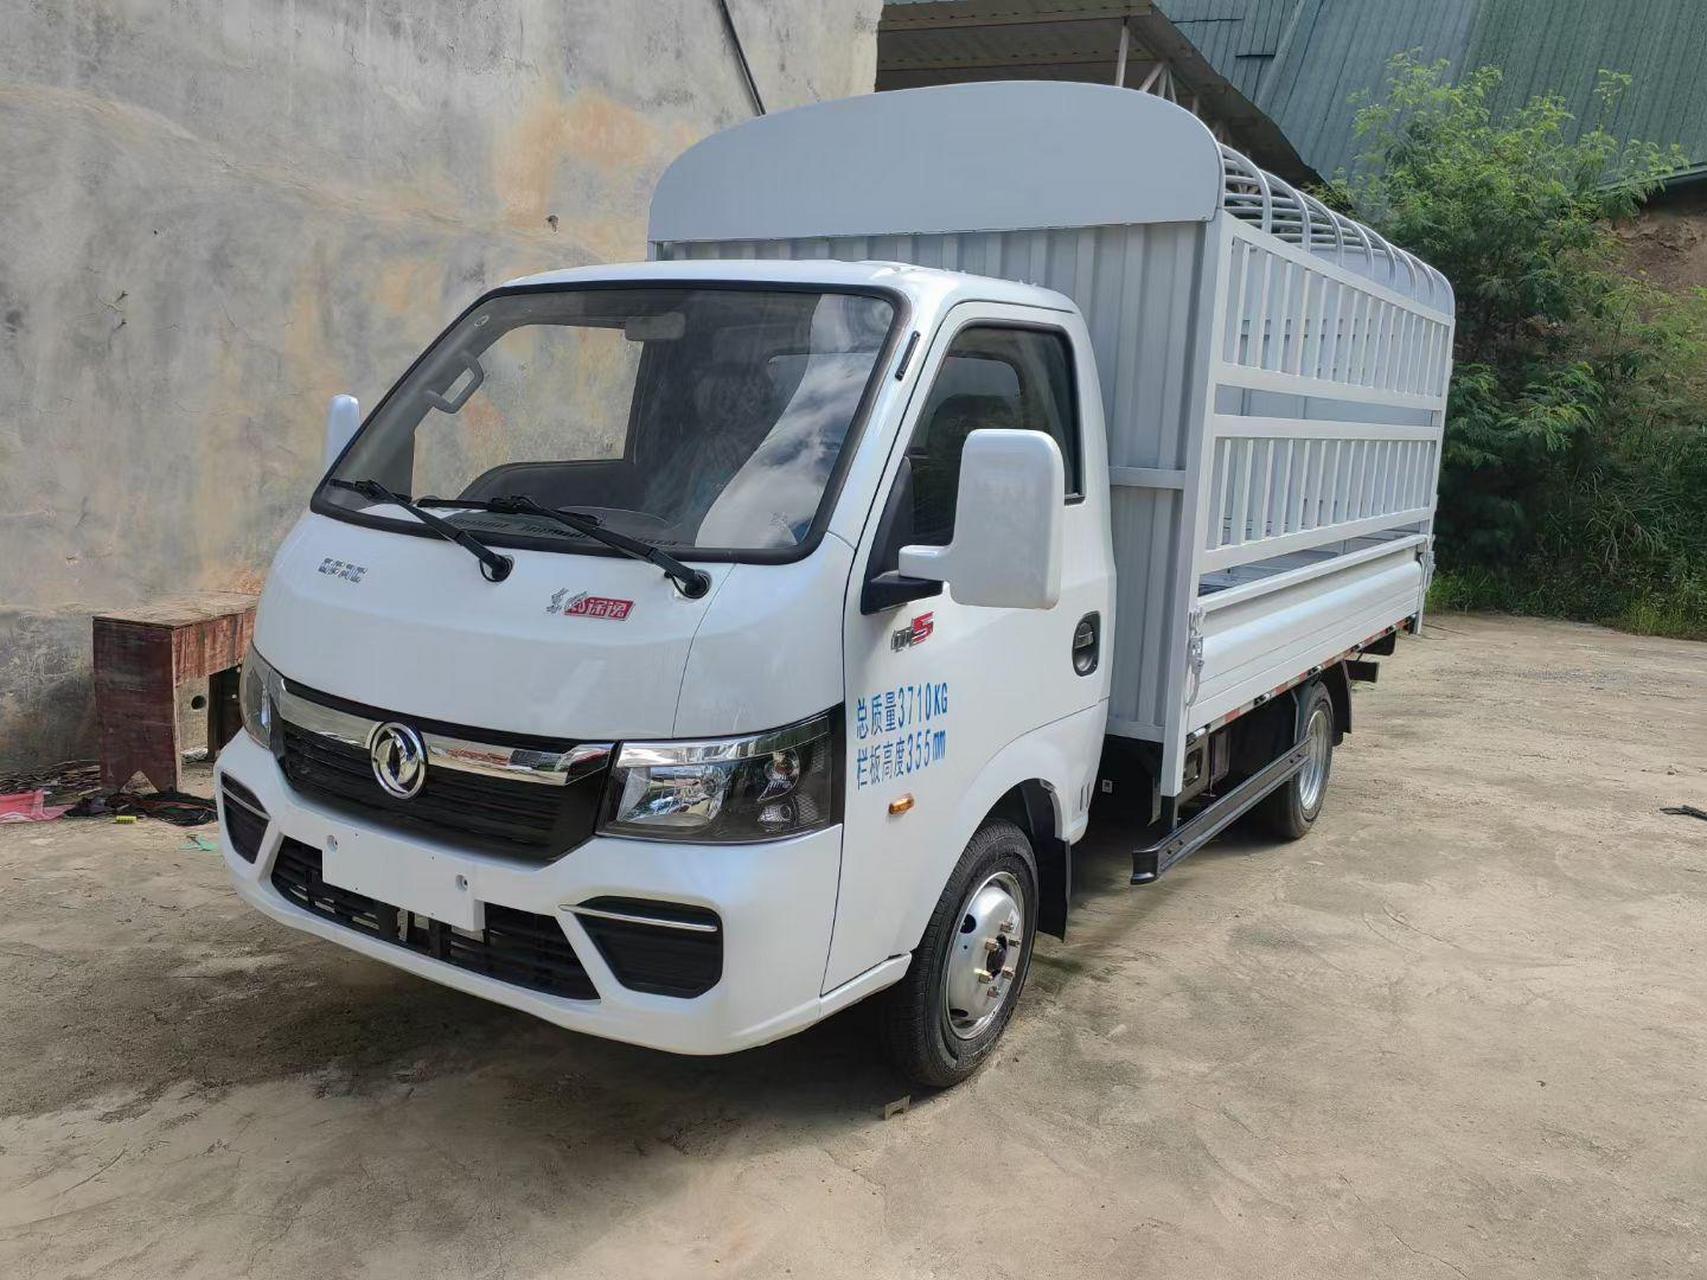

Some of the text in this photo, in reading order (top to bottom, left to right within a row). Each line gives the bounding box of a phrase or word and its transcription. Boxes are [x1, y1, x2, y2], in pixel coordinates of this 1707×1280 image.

[856, 682, 948, 740] 总质量3710KG
[856, 729, 946, 791] 栏板高度355mm
